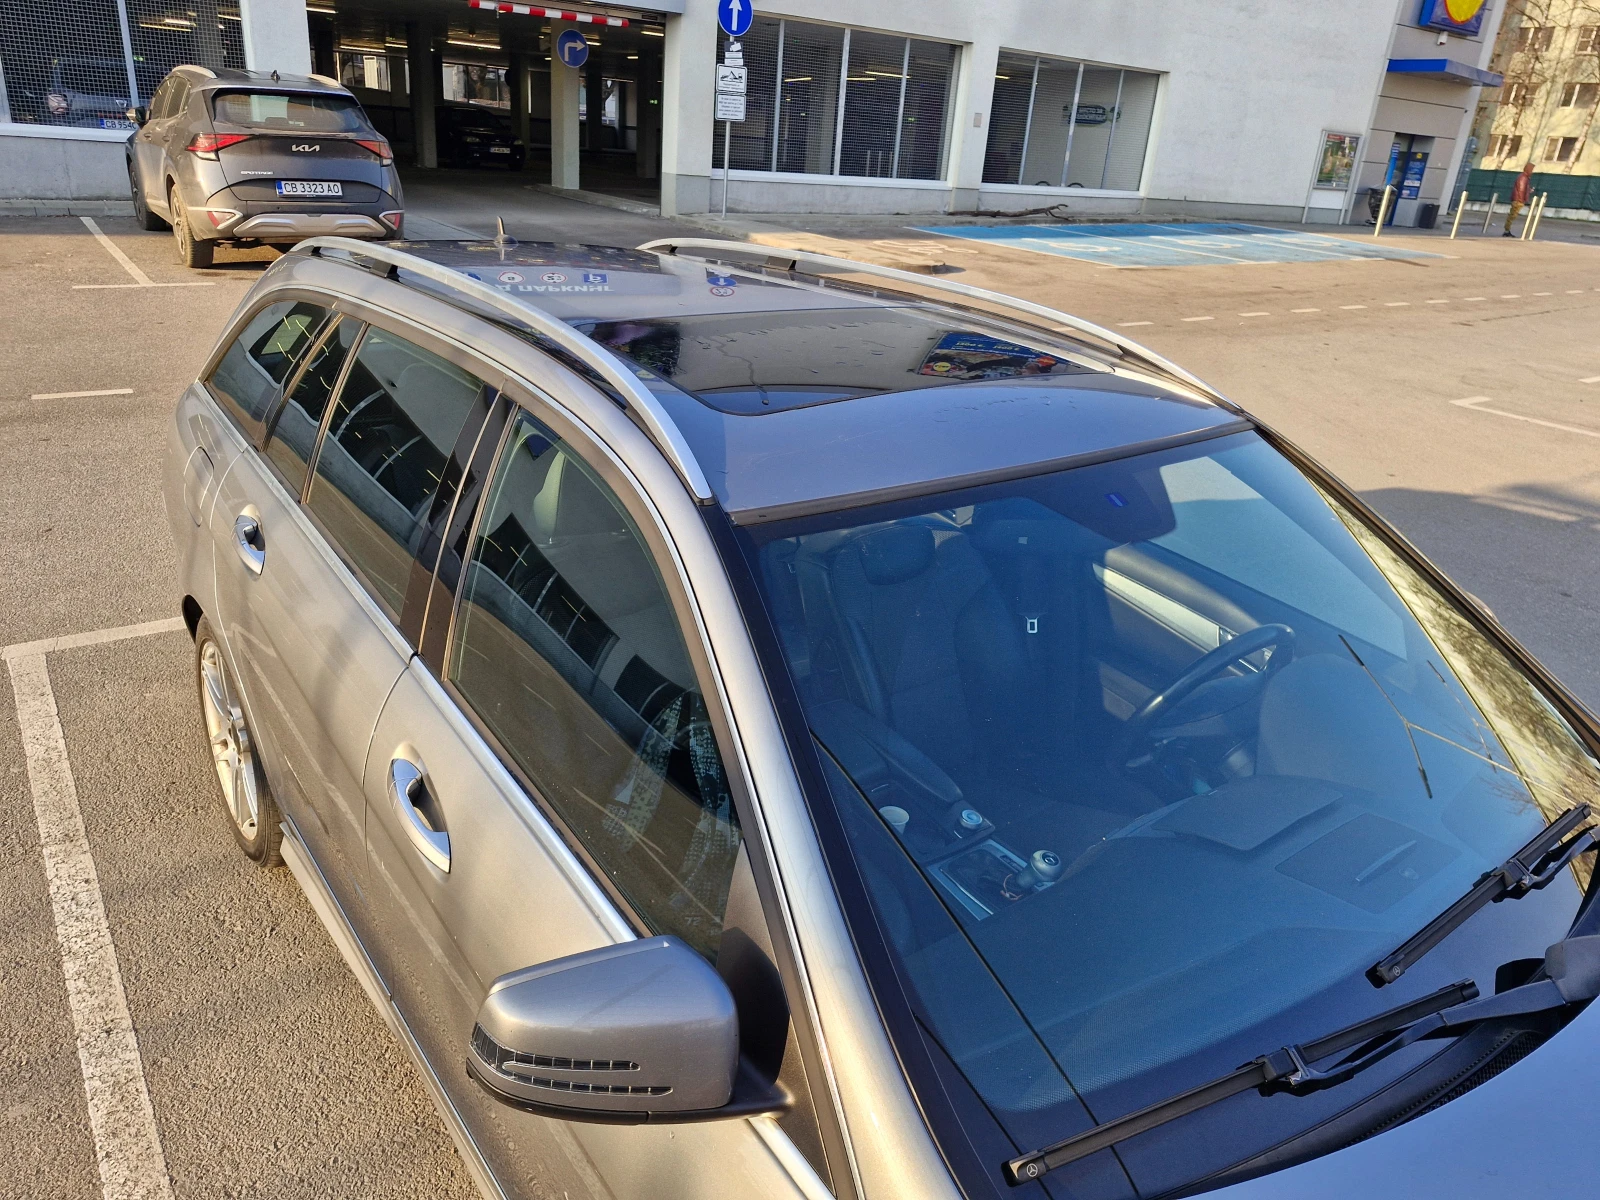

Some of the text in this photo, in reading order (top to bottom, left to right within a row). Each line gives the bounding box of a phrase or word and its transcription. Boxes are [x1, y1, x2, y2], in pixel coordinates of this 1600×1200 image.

[291, 144, 320, 152] KIA
[283, 182, 298, 193] CB
[300, 183, 325, 194] 3323
